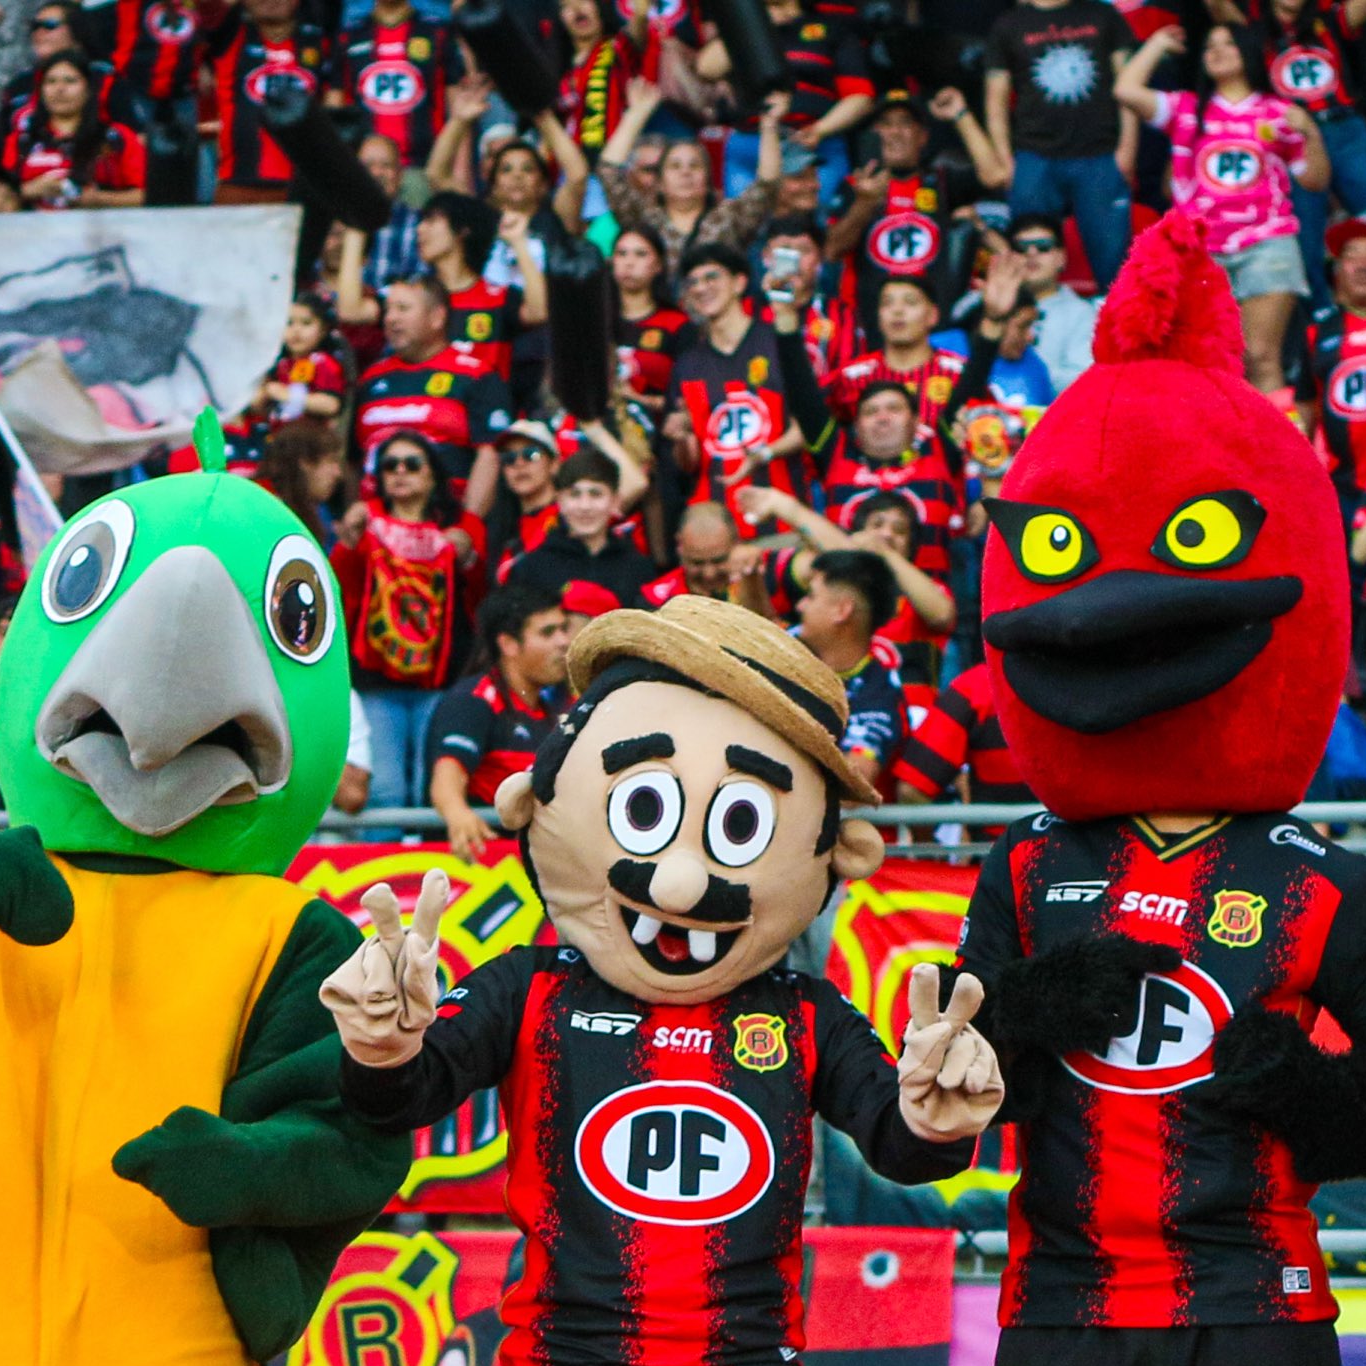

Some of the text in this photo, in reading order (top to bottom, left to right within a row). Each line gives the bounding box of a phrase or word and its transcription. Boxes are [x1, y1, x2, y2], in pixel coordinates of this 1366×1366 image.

[375, 73, 408, 99] PF
[1291, 58, 1322, 87] PF
[1218, 150, 1253, 179] PF
[888, 225, 924, 258] PF
[719, 408, 753, 444] PF
[1119, 891, 1189, 926] scm
[1228, 907, 1247, 927] R
[652, 1026, 713, 1054] scm
[751, 1031, 769, 1050] R
[626, 1110, 727, 1197] PF
